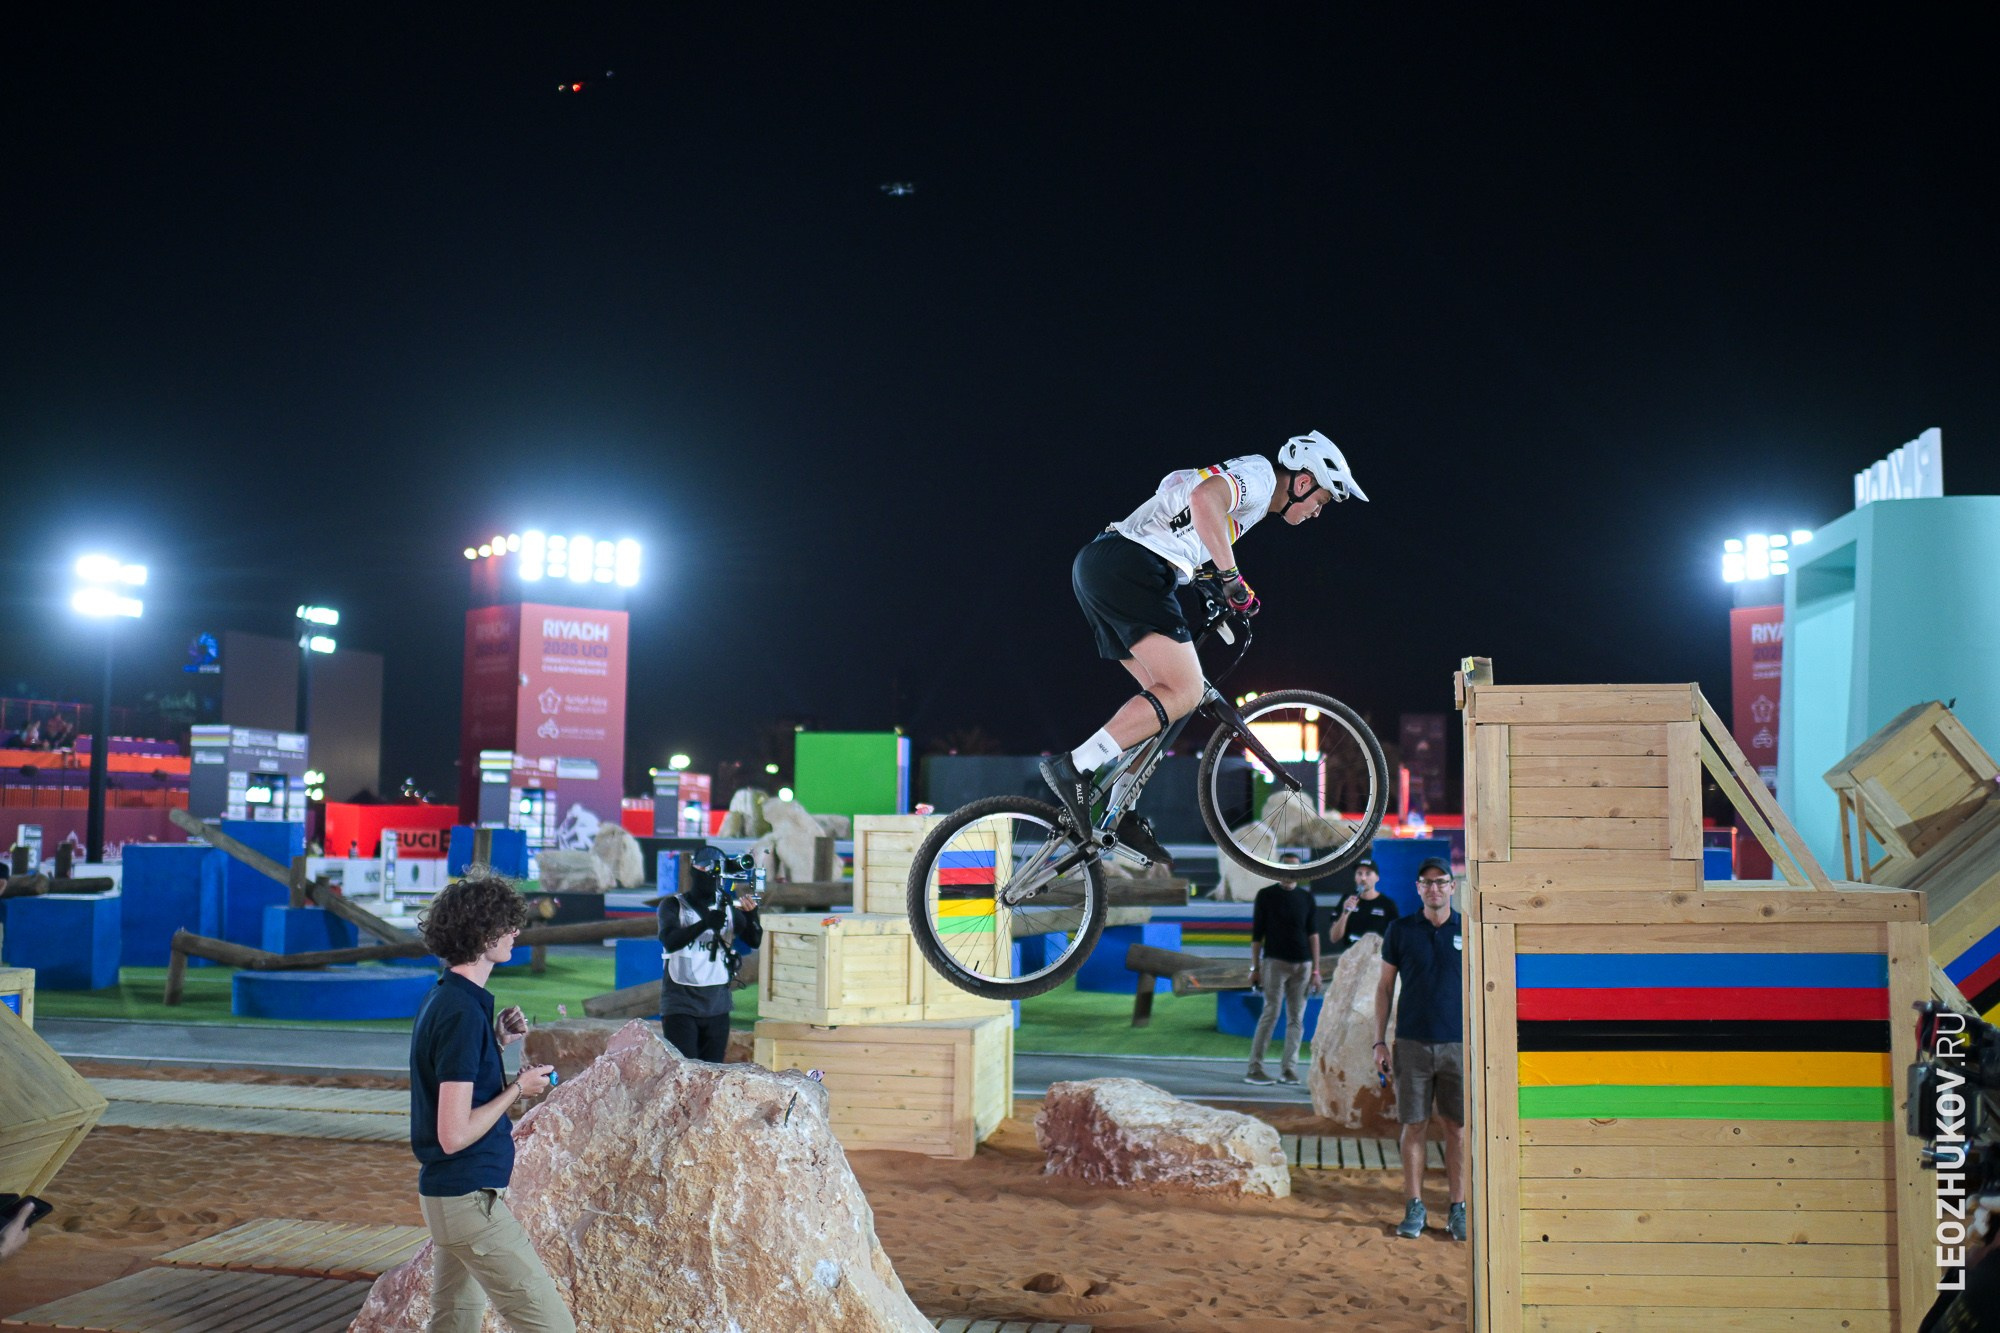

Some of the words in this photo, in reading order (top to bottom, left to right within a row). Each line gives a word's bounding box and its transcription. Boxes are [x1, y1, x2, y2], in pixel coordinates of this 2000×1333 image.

[543, 619, 609, 642] RIYADH
[582, 644, 608, 658] UCI
[403, 832, 437, 848] UCI
